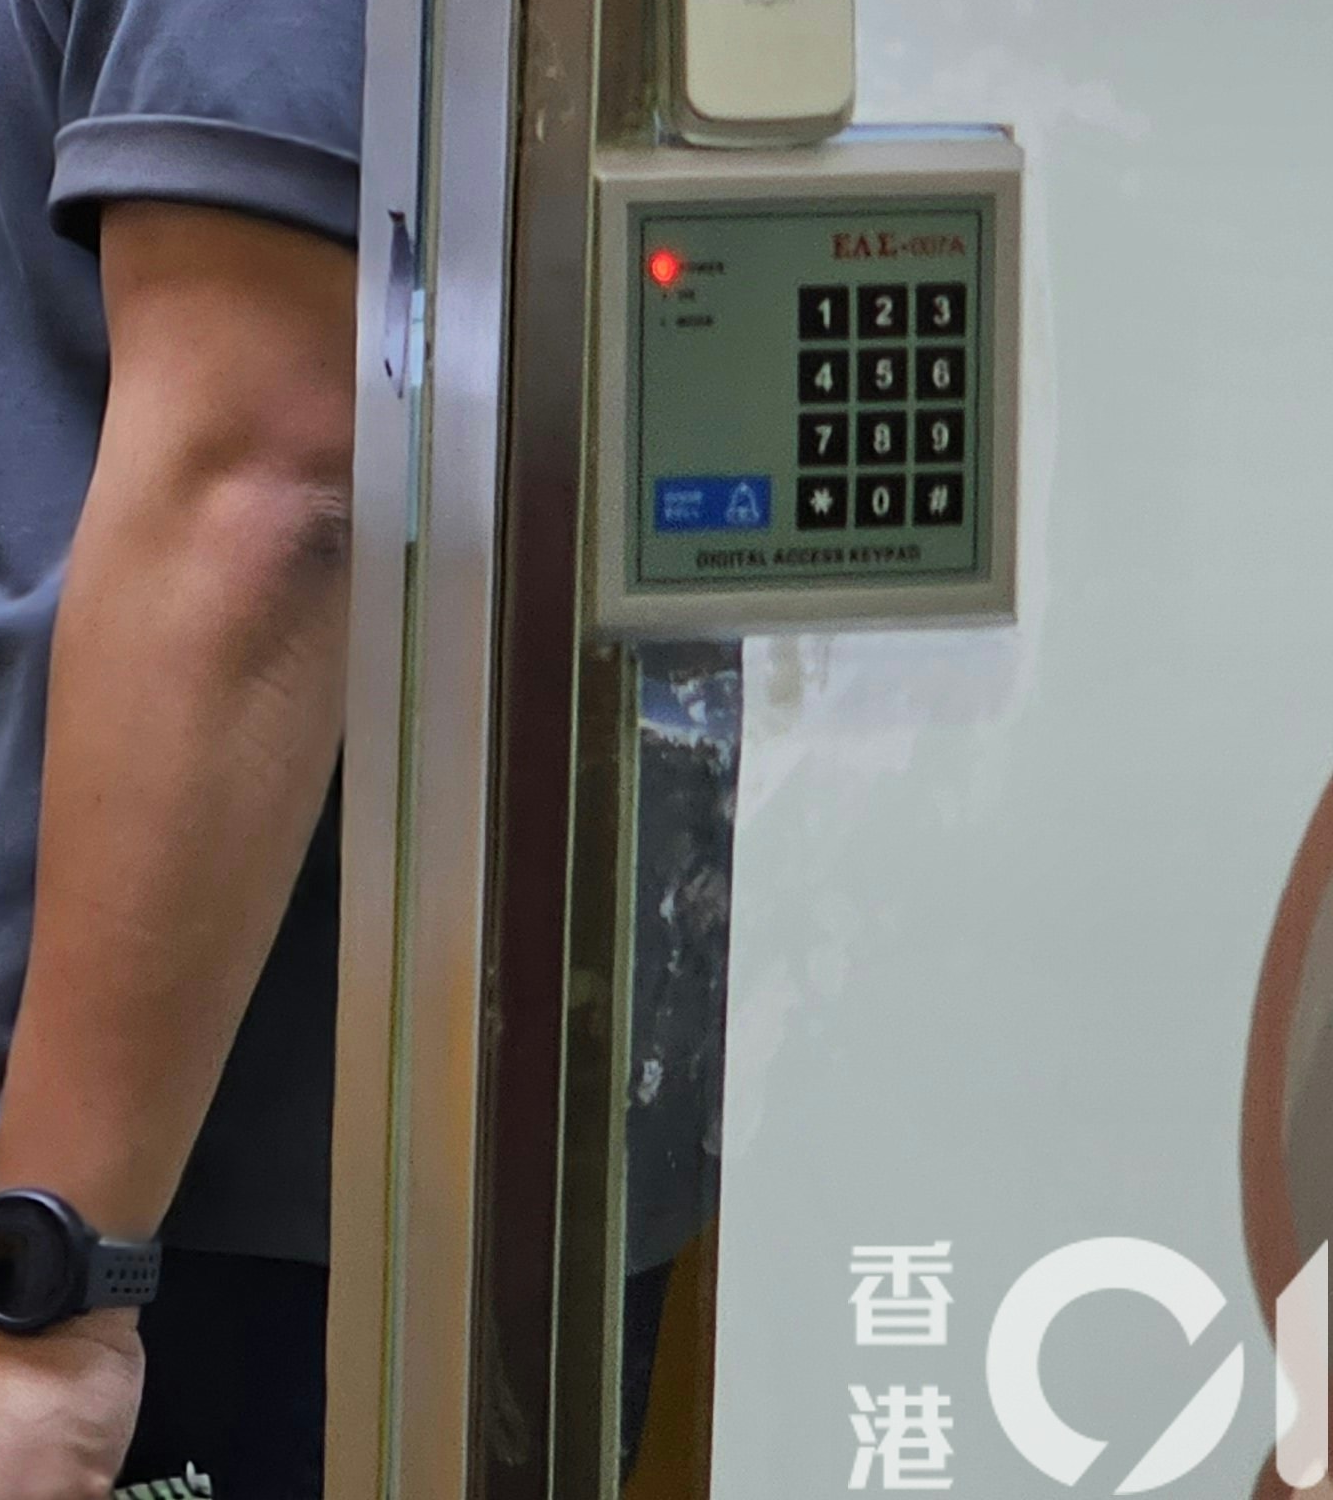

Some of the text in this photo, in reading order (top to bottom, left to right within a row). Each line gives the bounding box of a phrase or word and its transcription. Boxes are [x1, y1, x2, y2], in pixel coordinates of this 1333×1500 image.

[818, 294, 951, 330] 1 2 3
[815, 358, 950, 392] 4 5 6
[814, 421, 949, 455] 7 8 9
[871, 486, 890, 517] 0
